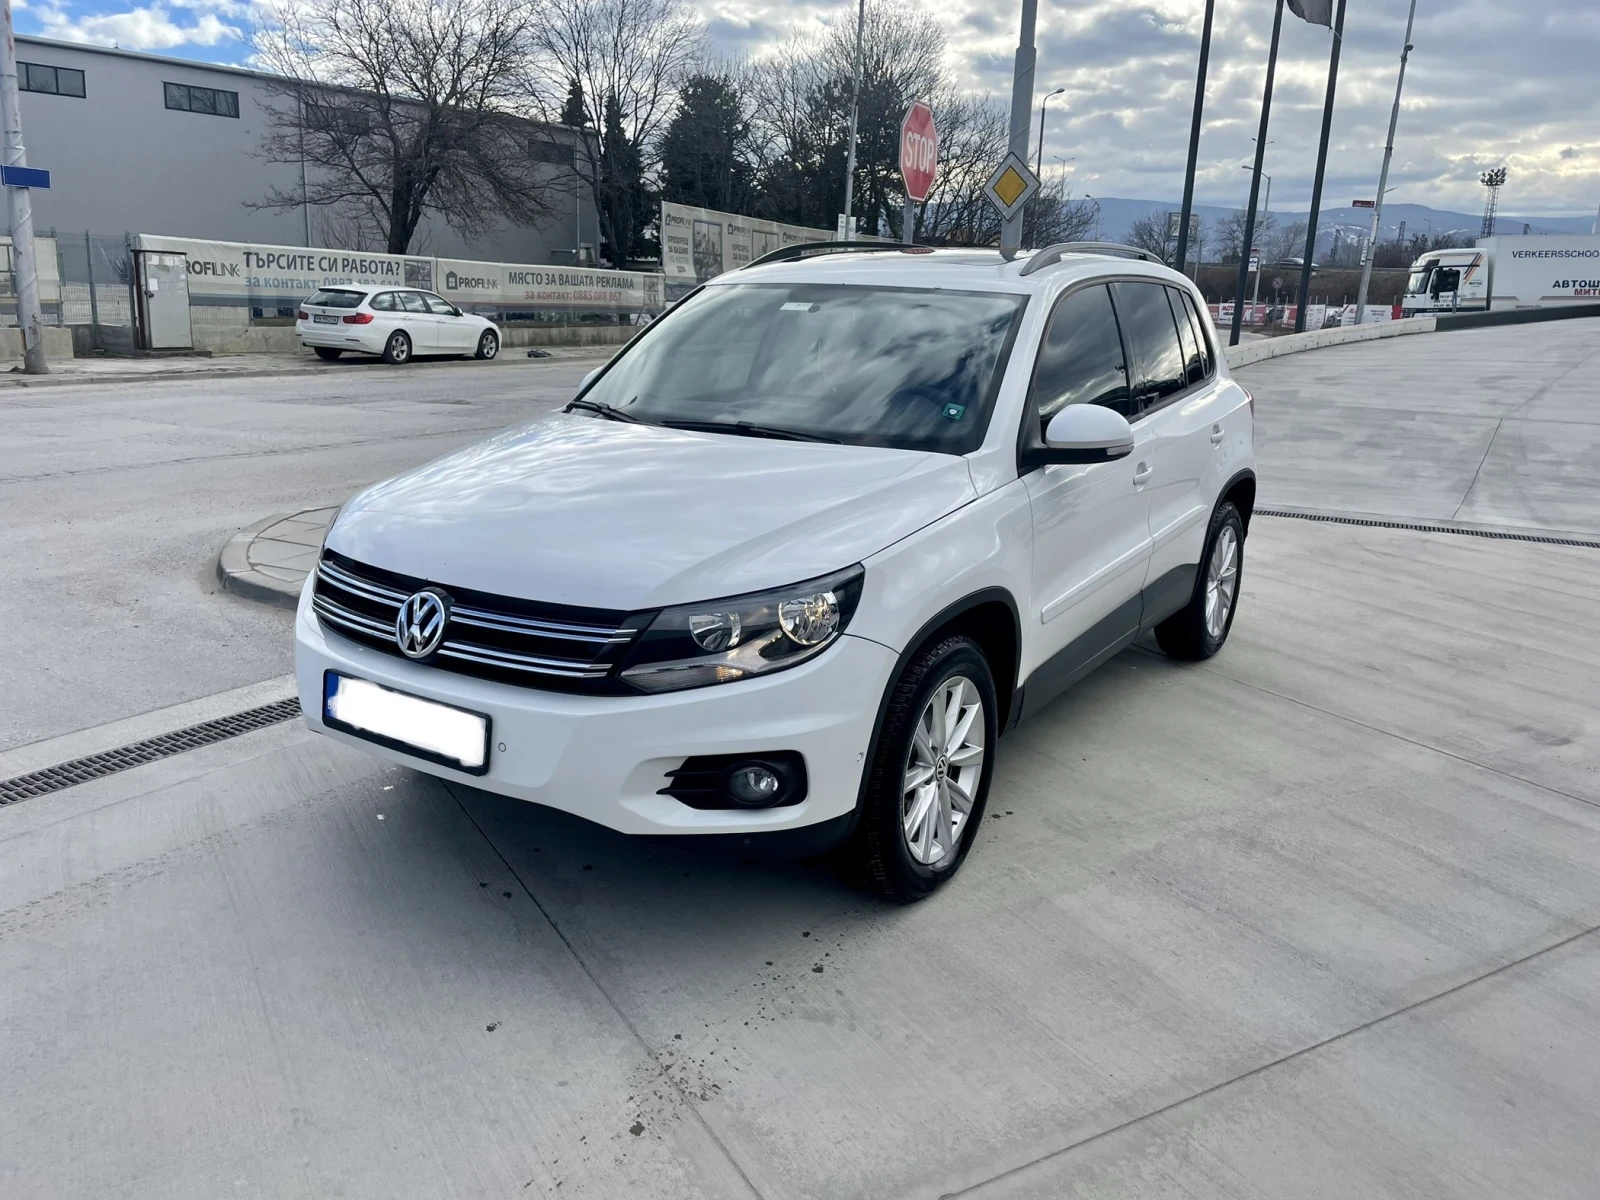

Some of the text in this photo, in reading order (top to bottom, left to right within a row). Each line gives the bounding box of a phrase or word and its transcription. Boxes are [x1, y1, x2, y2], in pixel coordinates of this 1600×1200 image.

[905, 131, 934, 173] STOP
[243, 252, 401, 276] ТЪРСИТЕ СИ РАБОТА?
[245, 277, 260, 288] за
[264, 278, 320, 289] контакт:
[459, 277, 498, 289] PROFILINK
[508, 272, 634, 289] МЯСТО ЗА ВАШАТА РЕКЛАМА
[525, 291, 535, 300] за
[536, 291, 572, 300] контакт:
[573, 290, 593, 301] 0885
[609, 291, 622, 302] 867
